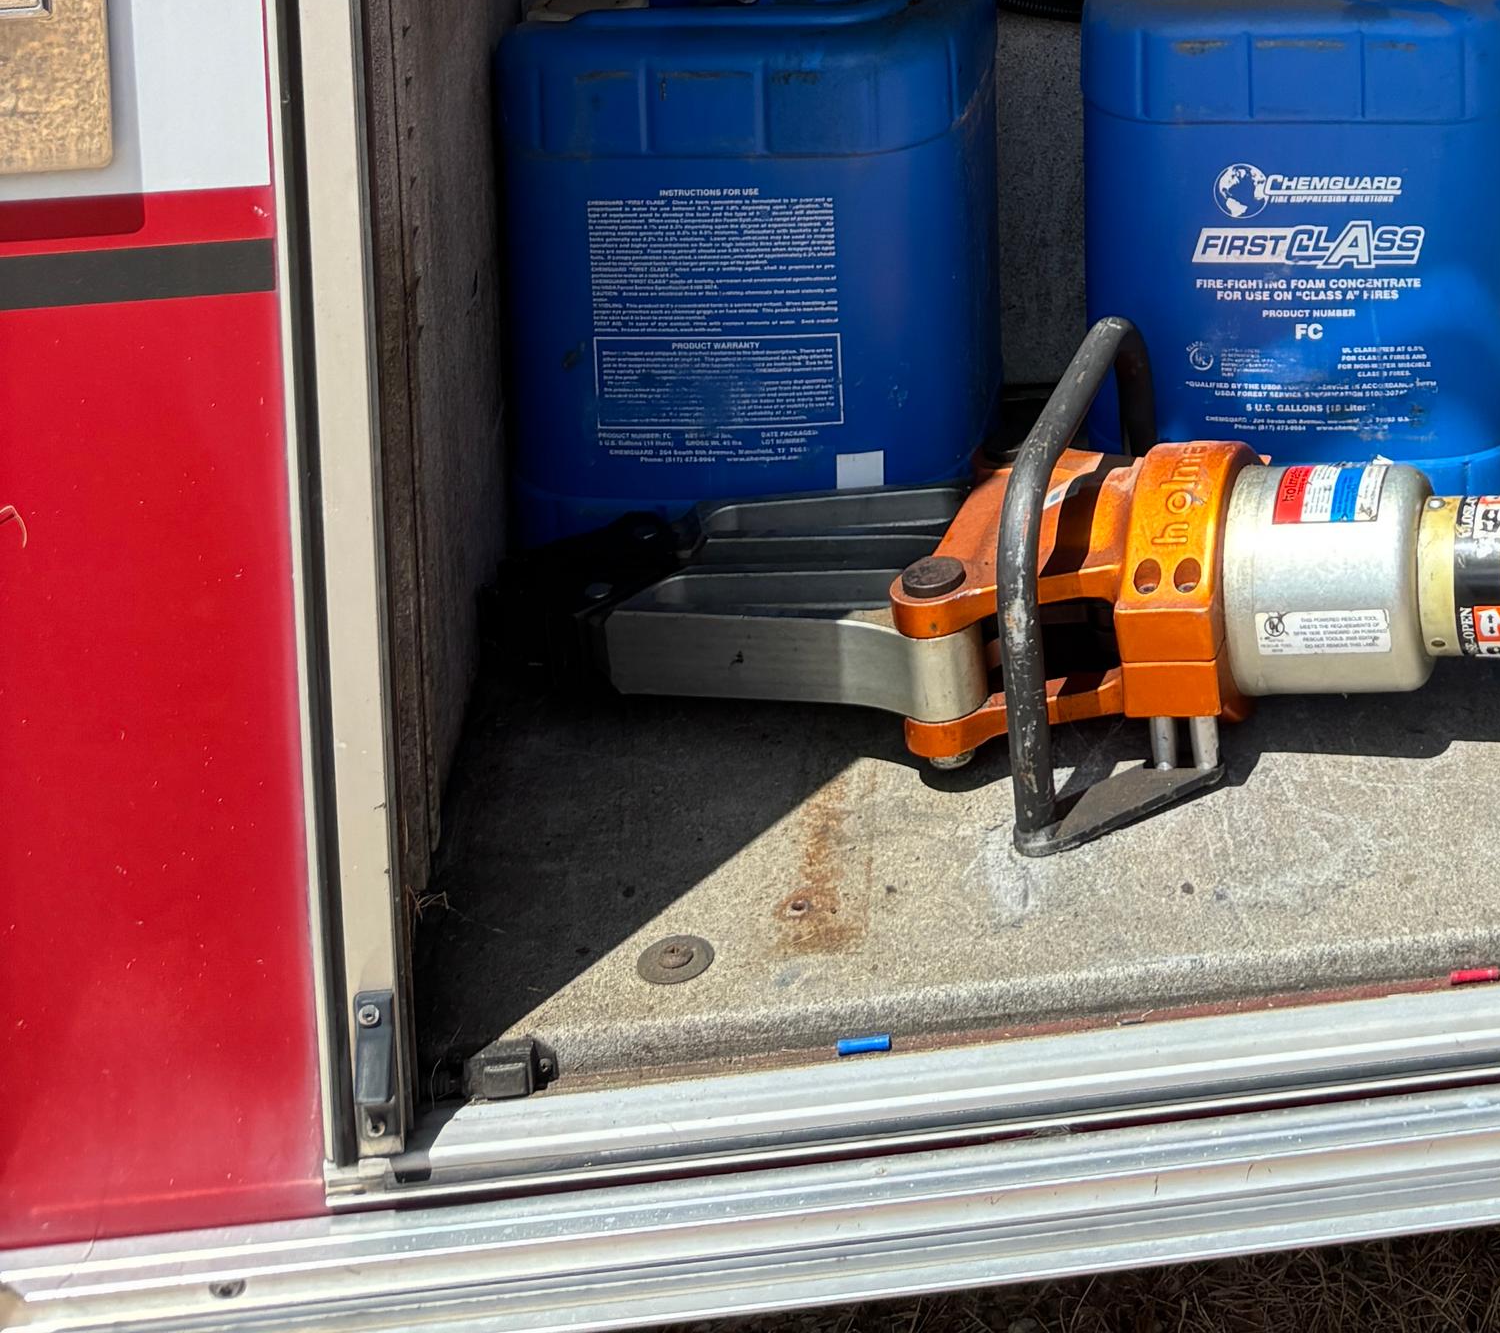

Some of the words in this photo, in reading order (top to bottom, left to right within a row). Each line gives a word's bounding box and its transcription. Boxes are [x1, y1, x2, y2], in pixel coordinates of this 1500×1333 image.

[1265, 174, 1402, 194] CHEMGUARD
[660, 189, 721, 197] INSTRUCTIONS
[723, 188, 741, 196] FOR
[1290, 279, 1326, 289] FOAM
[1329, 278, 1421, 289] CONCENTRATE
[1217, 291, 1241, 301] FOR
[1245, 291, 1269, 301] USE
[1273, 291, 1292, 300] ON
[1262, 309, 1310, 318] PRODUCT
[1313, 309, 1355, 318] NUMBER
[1295, 323, 1323, 340] FC
[672, 342, 711, 350] PRODUCT
[713, 341, 760, 349] WARRANTY
[1276, 404, 1323, 412] GALLONS
